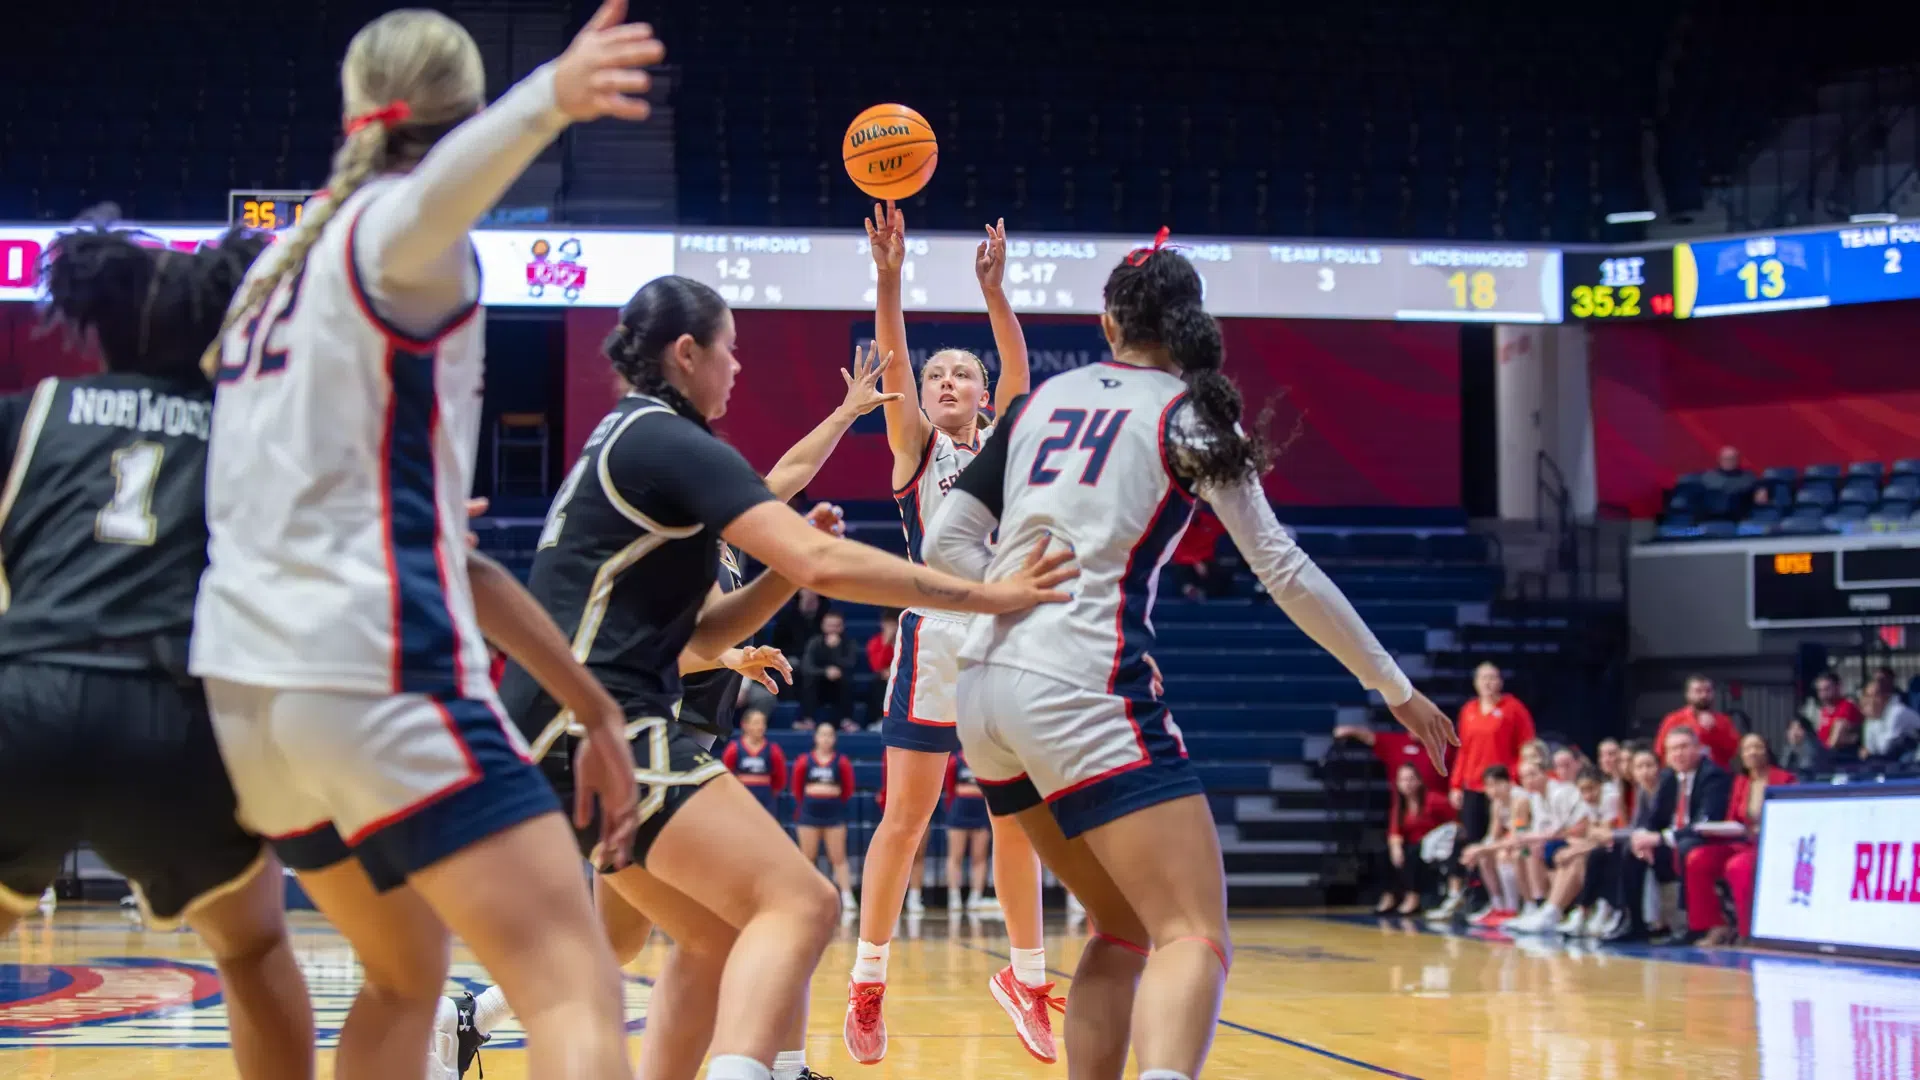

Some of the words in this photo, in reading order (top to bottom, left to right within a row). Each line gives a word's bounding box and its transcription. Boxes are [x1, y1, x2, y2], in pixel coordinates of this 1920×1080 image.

[850, 124, 910, 148] Wilson
[868, 155, 903, 174] EVO
[681, 235, 728, 252] FREE
[733, 236, 811, 253] THROWS
[1839, 227, 1888, 249] TEAM
[1034, 243, 1096, 259] GOALS
[1269, 246, 1319, 263] TEAM
[1322, 247, 1382, 264] FOULS
[1409, 250, 1528, 267] LINDENWOOD
[1883, 247, 1902, 274] 2
[717, 258, 751, 279] 1-2
[1008, 263, 1057, 284] 6-17
[1318, 267, 1335, 291] 3
[1737, 260, 1786, 299] 13
[1448, 271, 1497, 309] 18
[1571, 285, 1641, 317] 35.2
[1028, 408, 1132, 487] 24
[95, 440, 164, 546] 1
